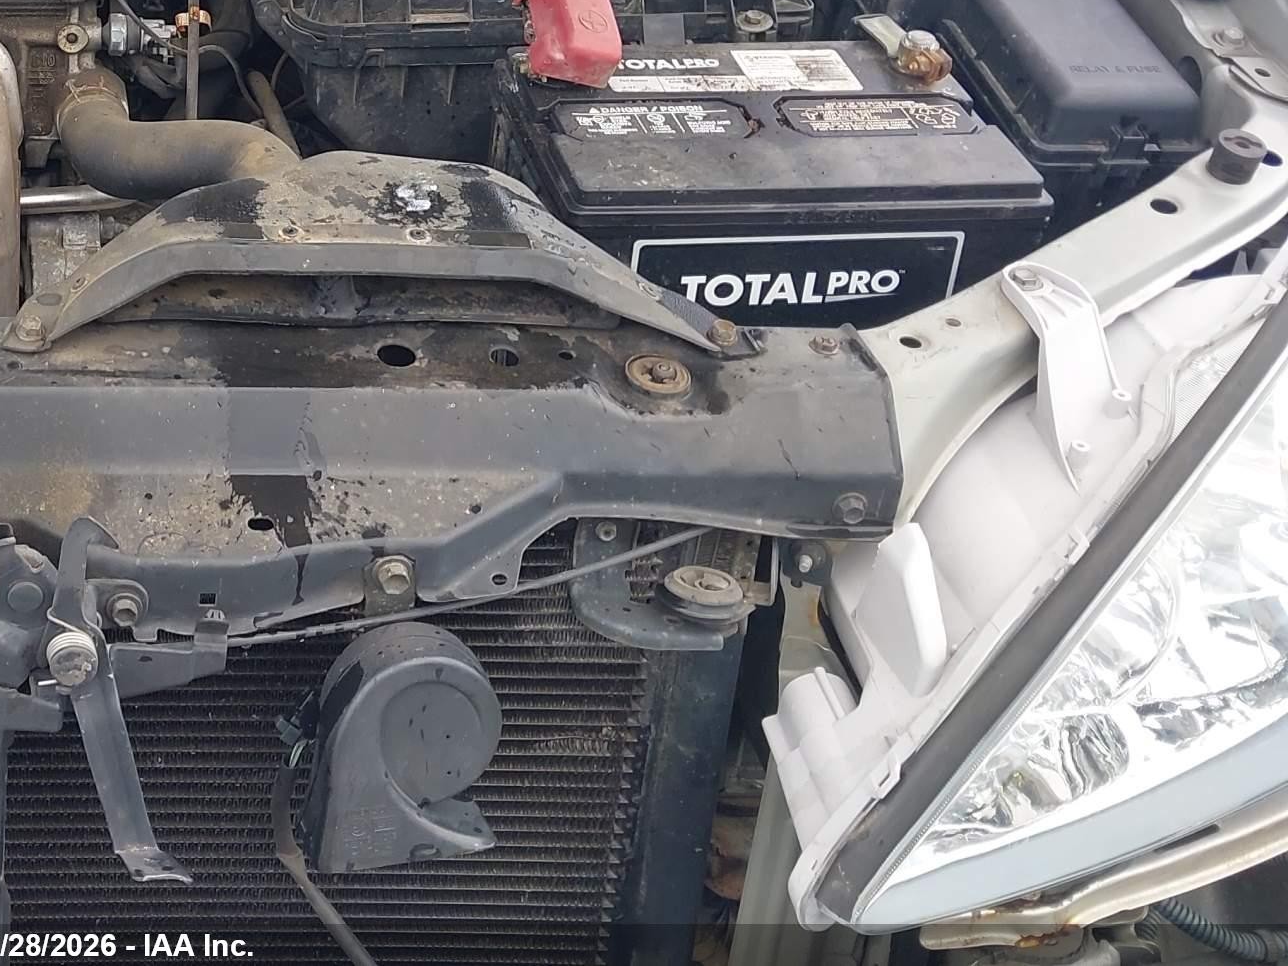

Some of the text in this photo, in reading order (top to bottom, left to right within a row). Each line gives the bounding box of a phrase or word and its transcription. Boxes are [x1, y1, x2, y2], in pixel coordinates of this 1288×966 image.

[1068, 65, 1111, 73] RELAY
[1126, 65, 1162, 73] FUSE
[599, 106, 649, 114] DANGER
[659, 105, 704, 113] POISON
